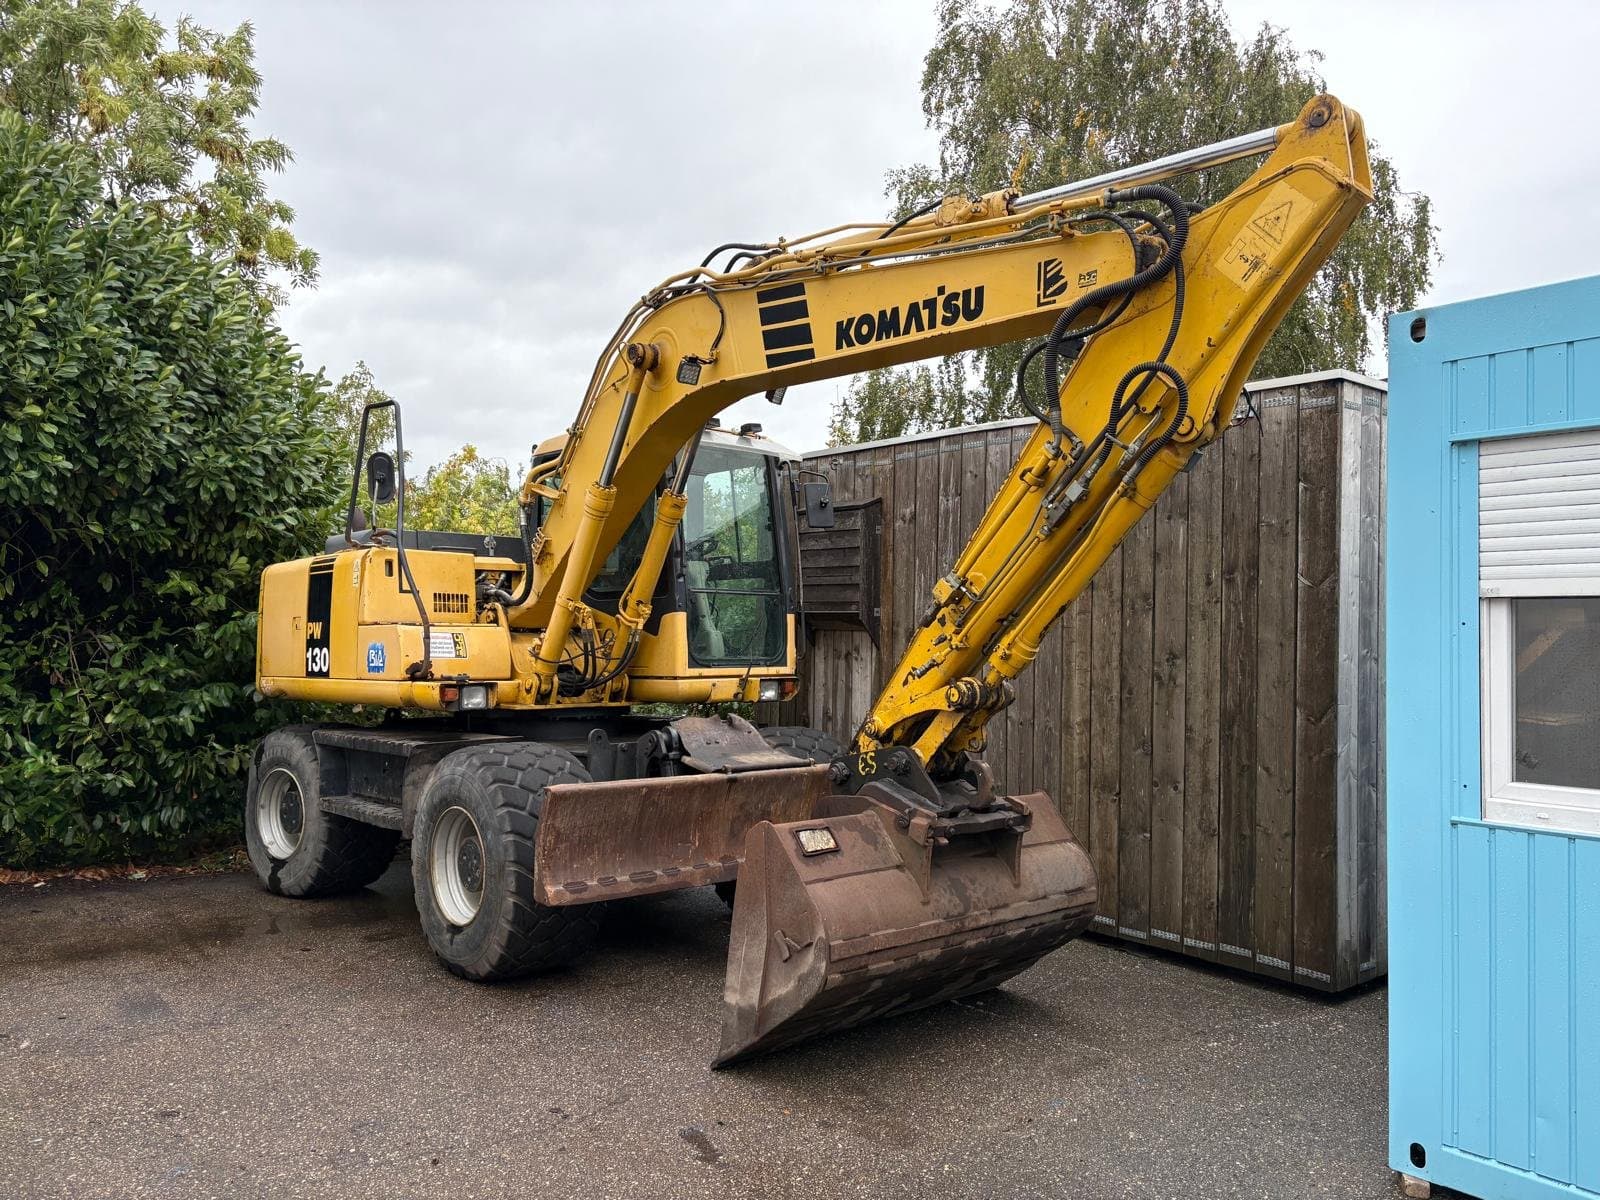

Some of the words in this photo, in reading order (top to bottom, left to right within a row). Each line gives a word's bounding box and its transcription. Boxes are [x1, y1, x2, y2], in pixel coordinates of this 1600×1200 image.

[836, 285, 984, 350] KOMATSU
[307, 622, 322, 639] PW
[306, 647, 329, 672] 130
